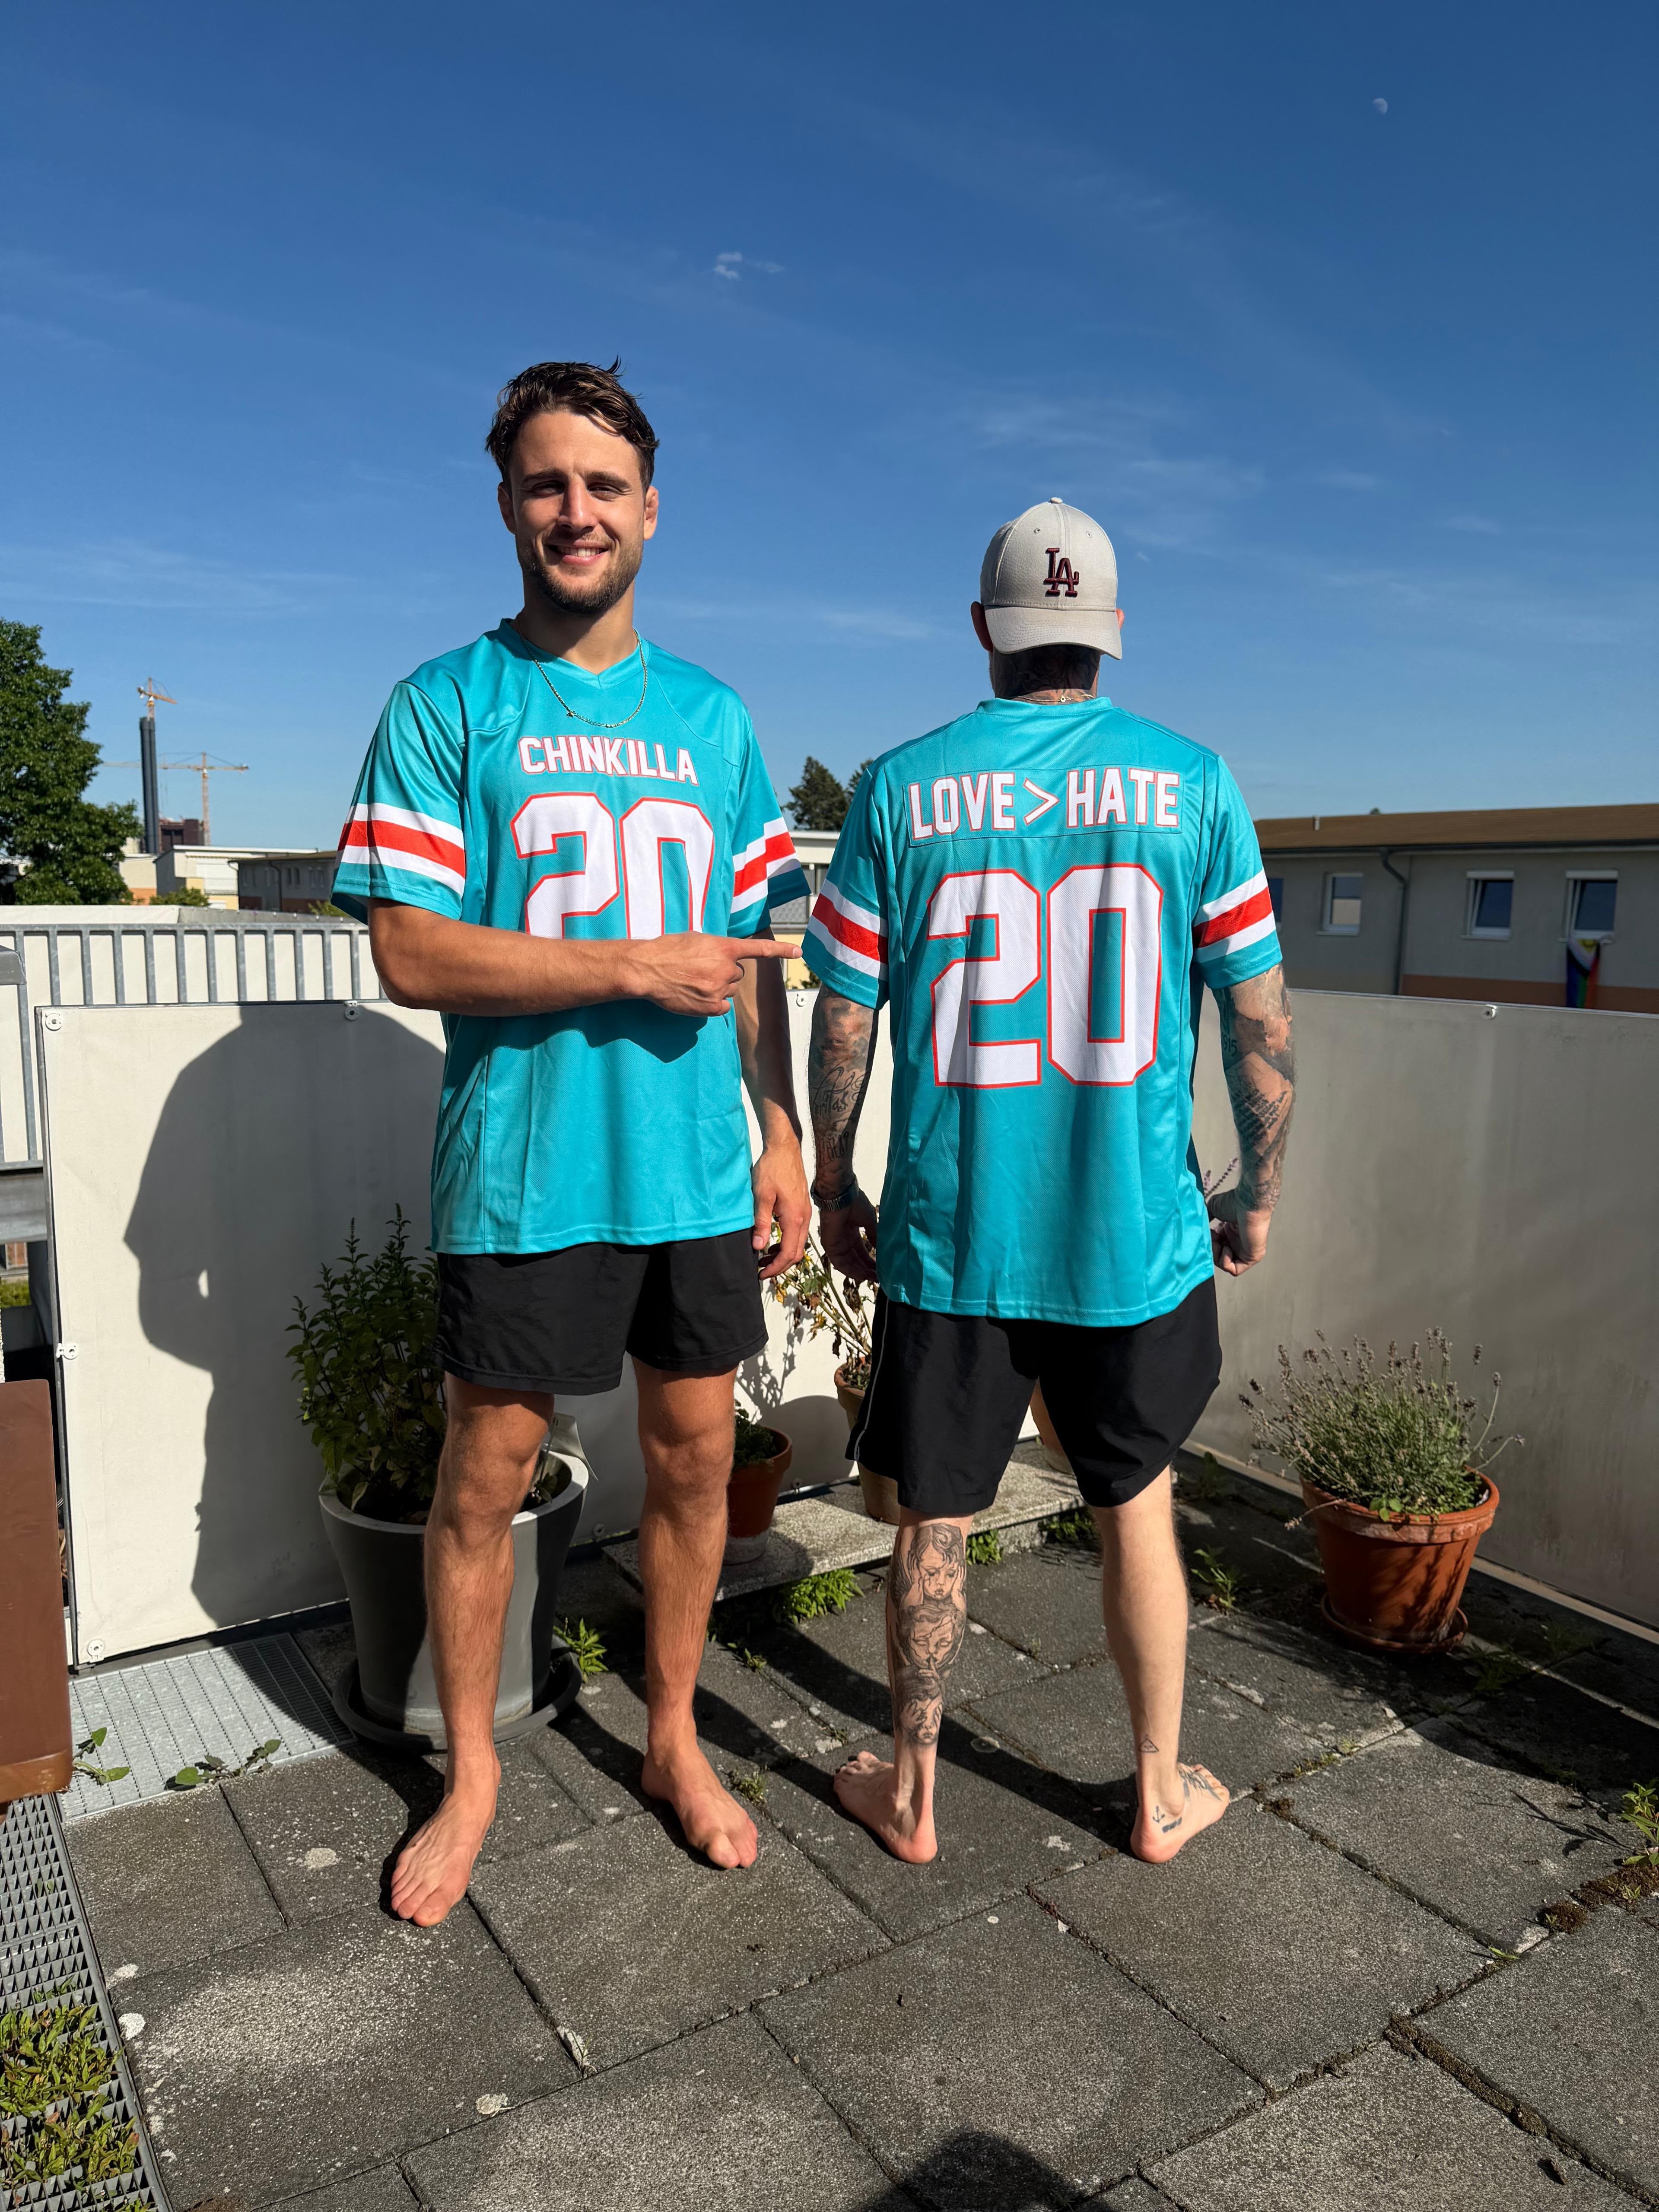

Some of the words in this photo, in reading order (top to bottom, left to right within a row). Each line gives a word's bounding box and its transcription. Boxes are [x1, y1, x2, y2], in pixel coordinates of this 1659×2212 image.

[1044, 547, 1079, 597] LA
[518, 735, 699, 786] CHINKILLA
[510, 792, 715, 940] 20
[926, 863, 1164, 1089] 20
